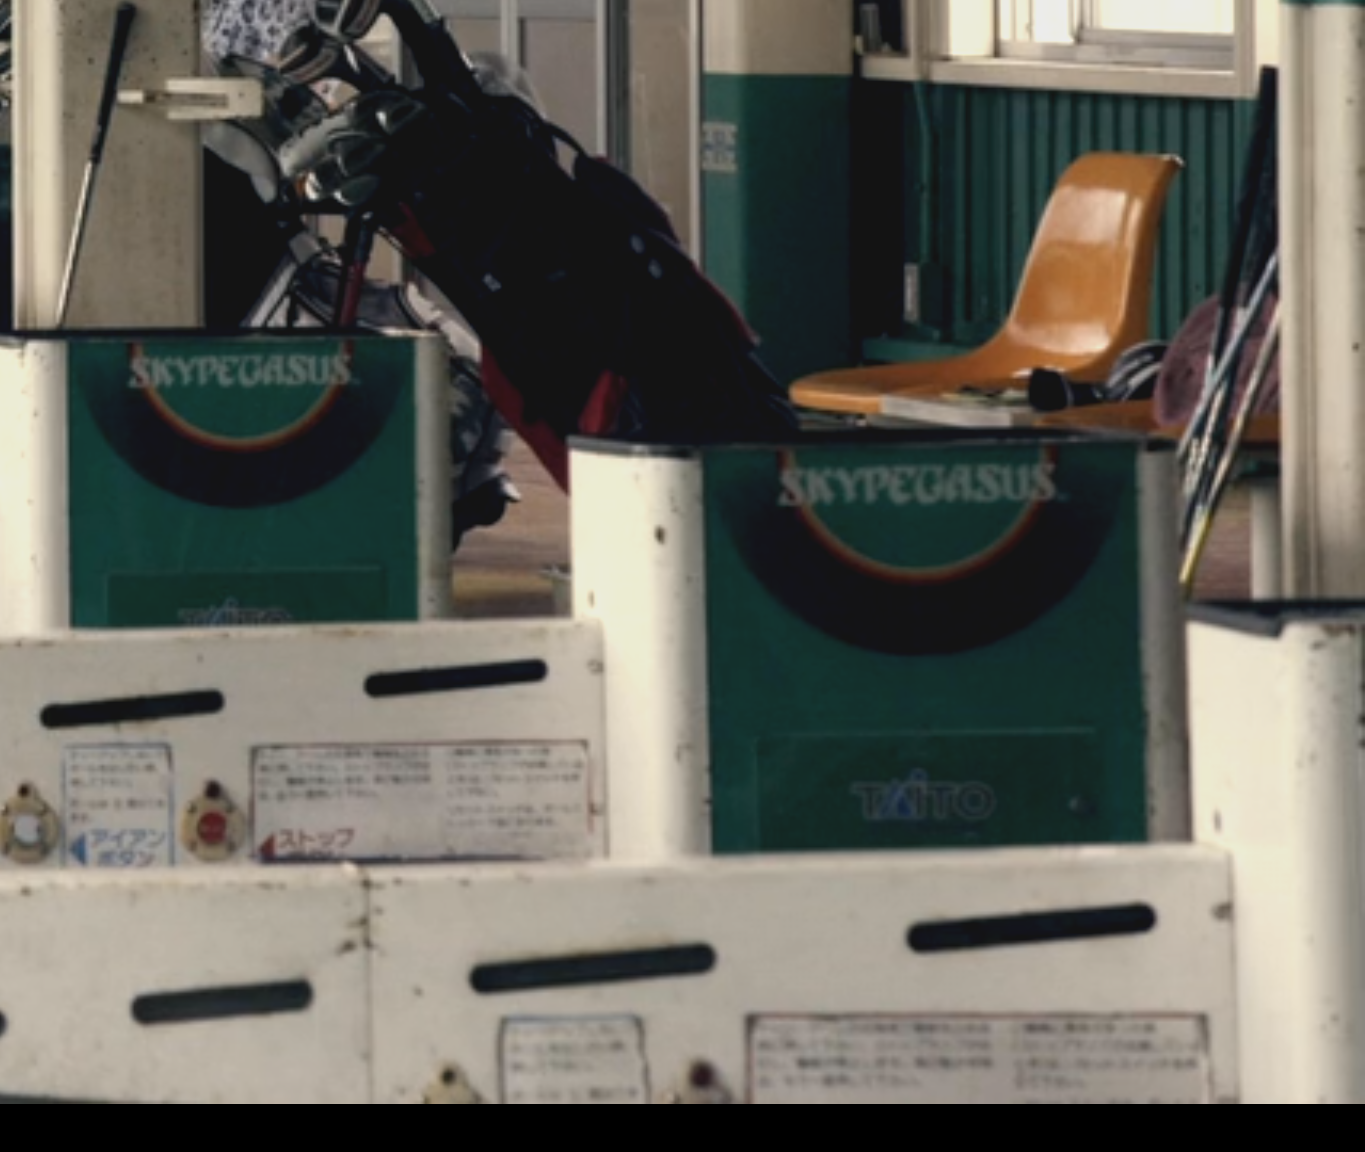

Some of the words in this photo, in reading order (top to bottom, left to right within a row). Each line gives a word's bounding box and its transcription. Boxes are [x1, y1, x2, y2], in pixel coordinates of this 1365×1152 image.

[127, 353, 351, 388] SKYPEGASUS
[777, 463, 1056, 507] SKYPEGASUS
[278, 828, 355, 848] ストップ
